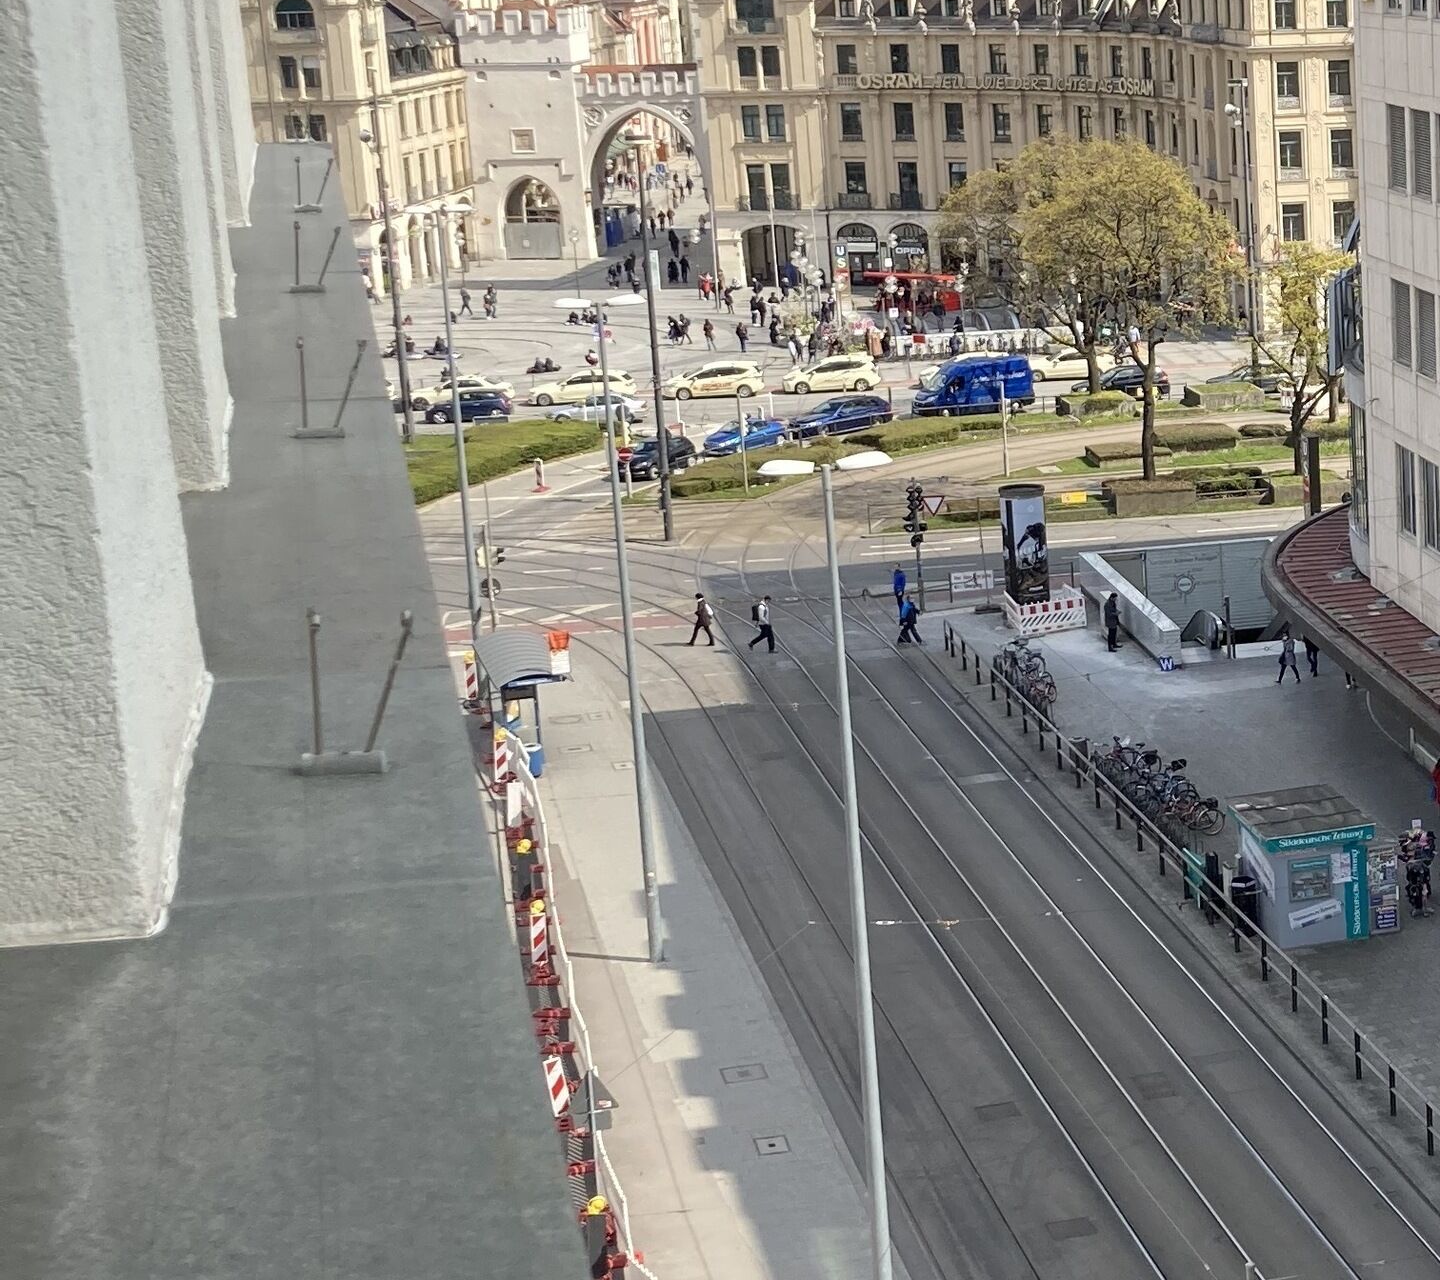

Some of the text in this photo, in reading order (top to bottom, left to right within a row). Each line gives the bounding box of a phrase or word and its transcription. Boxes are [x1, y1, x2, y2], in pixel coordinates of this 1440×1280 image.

[857, 73, 923, 89] OSRAM
[1118, 76, 1155, 97] OSRAM
[836, 246, 845, 255] U
[895, 247, 925, 255] OPEN
[837, 258, 847, 268] S
[1160, 658, 1173, 671] W
